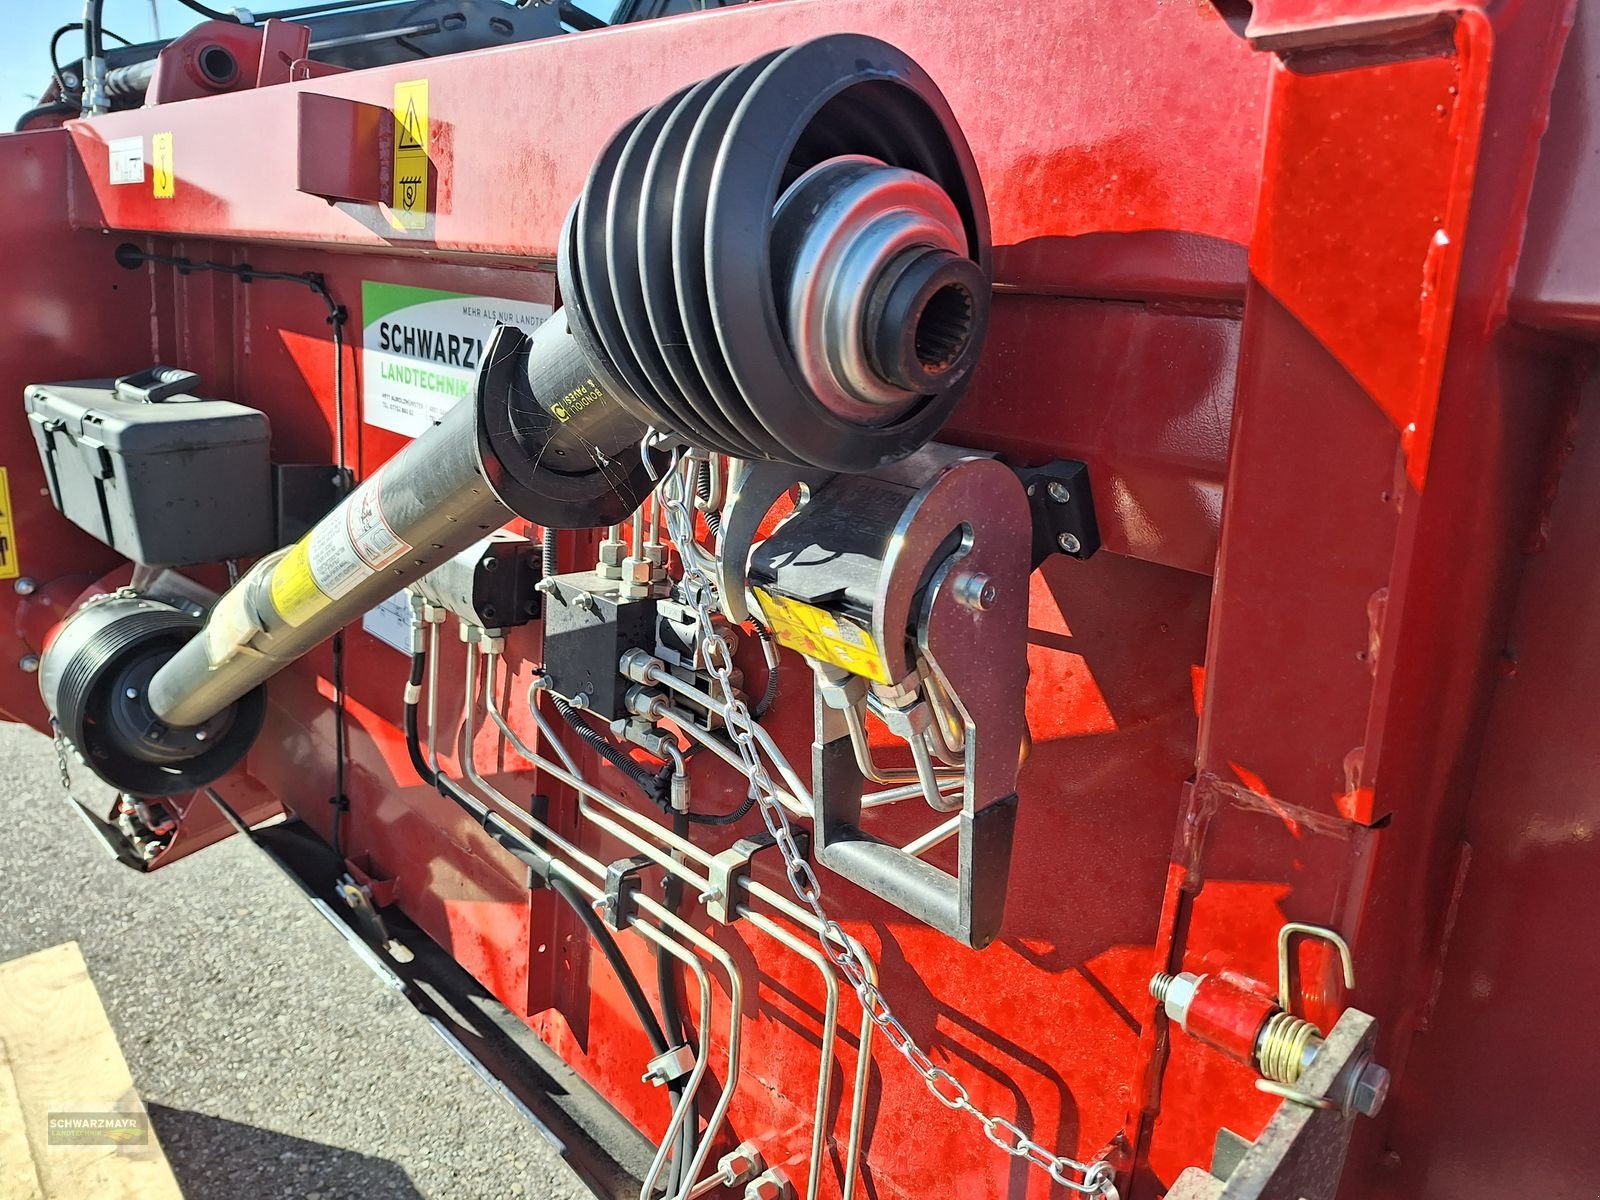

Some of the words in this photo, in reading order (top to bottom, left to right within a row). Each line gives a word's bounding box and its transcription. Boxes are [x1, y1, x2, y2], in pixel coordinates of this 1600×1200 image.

[463, 306, 480, 316] MEHR
[484, 309, 496, 319] ALS
[499, 312, 513, 322] NUR
[516, 314, 547, 326] LANDTE
[381, 361, 469, 398] LANDTECHNIK
[587, 379, 596, 388] &
[563, 385, 588, 406] PAVESI
[569, 388, 603, 415] BONDIOLI
